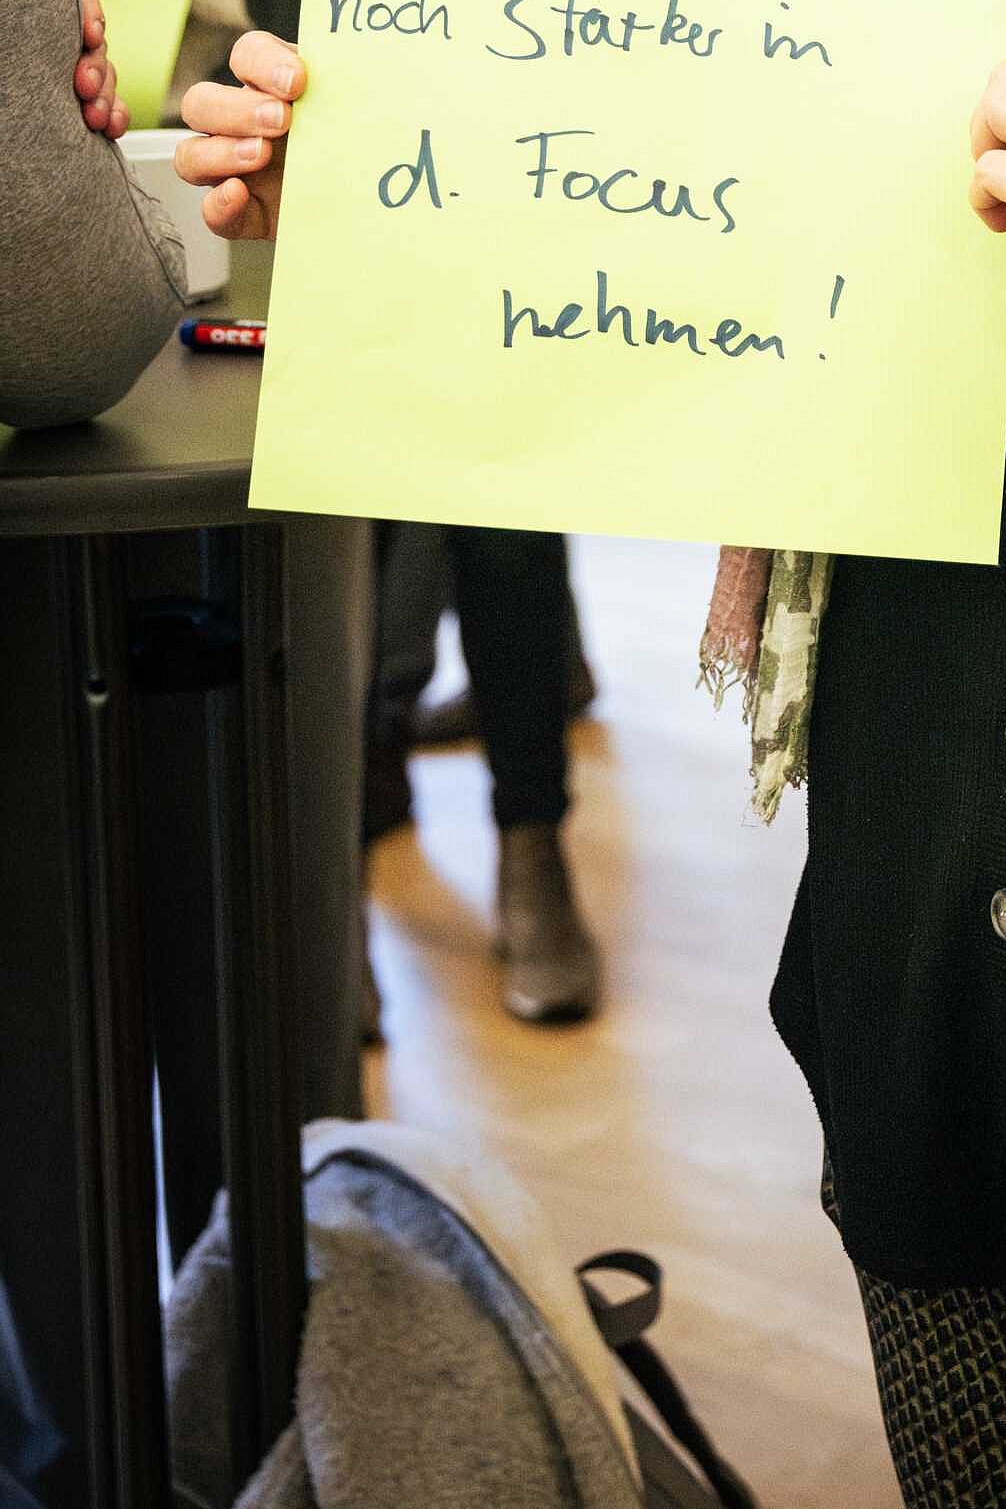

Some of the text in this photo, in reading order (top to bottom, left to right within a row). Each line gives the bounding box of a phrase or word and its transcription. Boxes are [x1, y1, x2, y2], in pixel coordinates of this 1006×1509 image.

[763, 3, 834, 68] in
[378, 129, 740, 235] d. Focus
